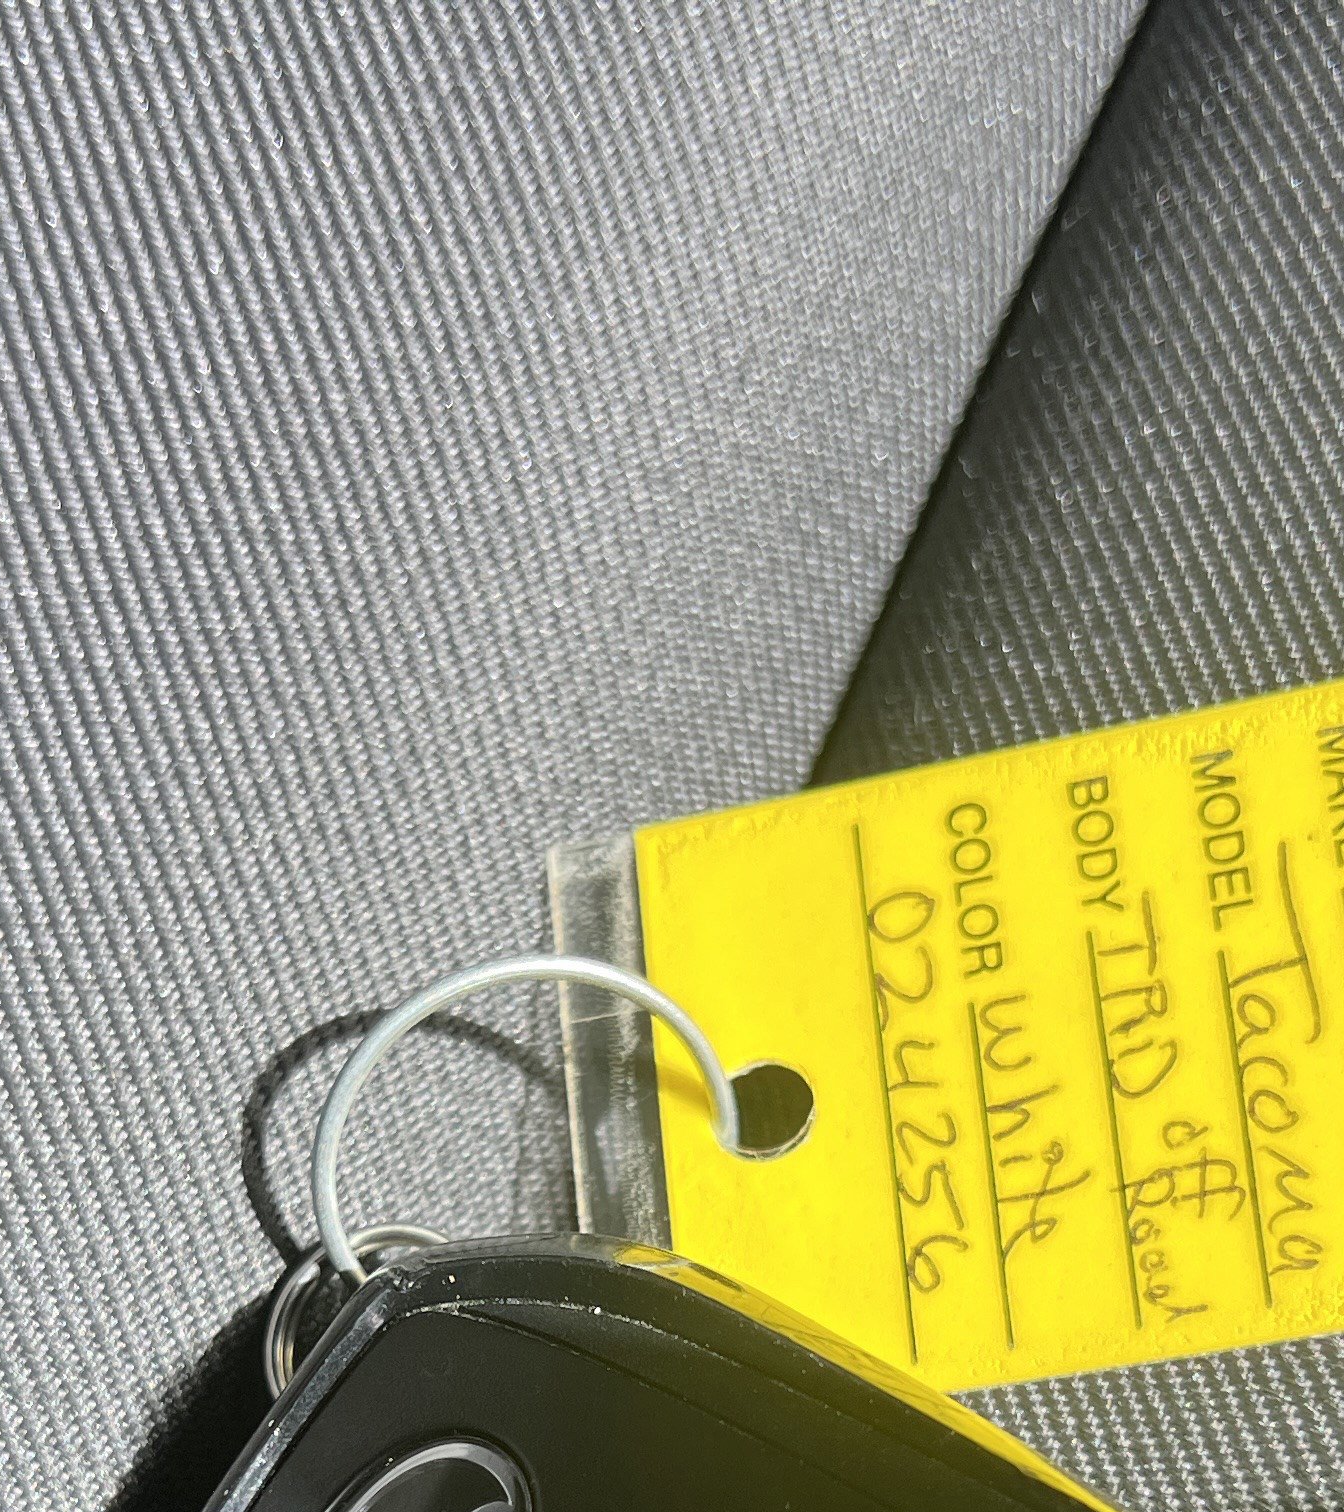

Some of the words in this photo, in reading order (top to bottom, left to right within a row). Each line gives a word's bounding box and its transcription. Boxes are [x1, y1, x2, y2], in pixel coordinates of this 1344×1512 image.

[944, 801, 1004, 981] COLOR
[1066, 774, 1128, 914] BODY
[1189, 747, 1254, 933] MODEL
[865, 889, 969, 1293] 024256
[1096, 889, 1178, 1100] TRD
[1227, 841, 1323, 1279] Tacoma
